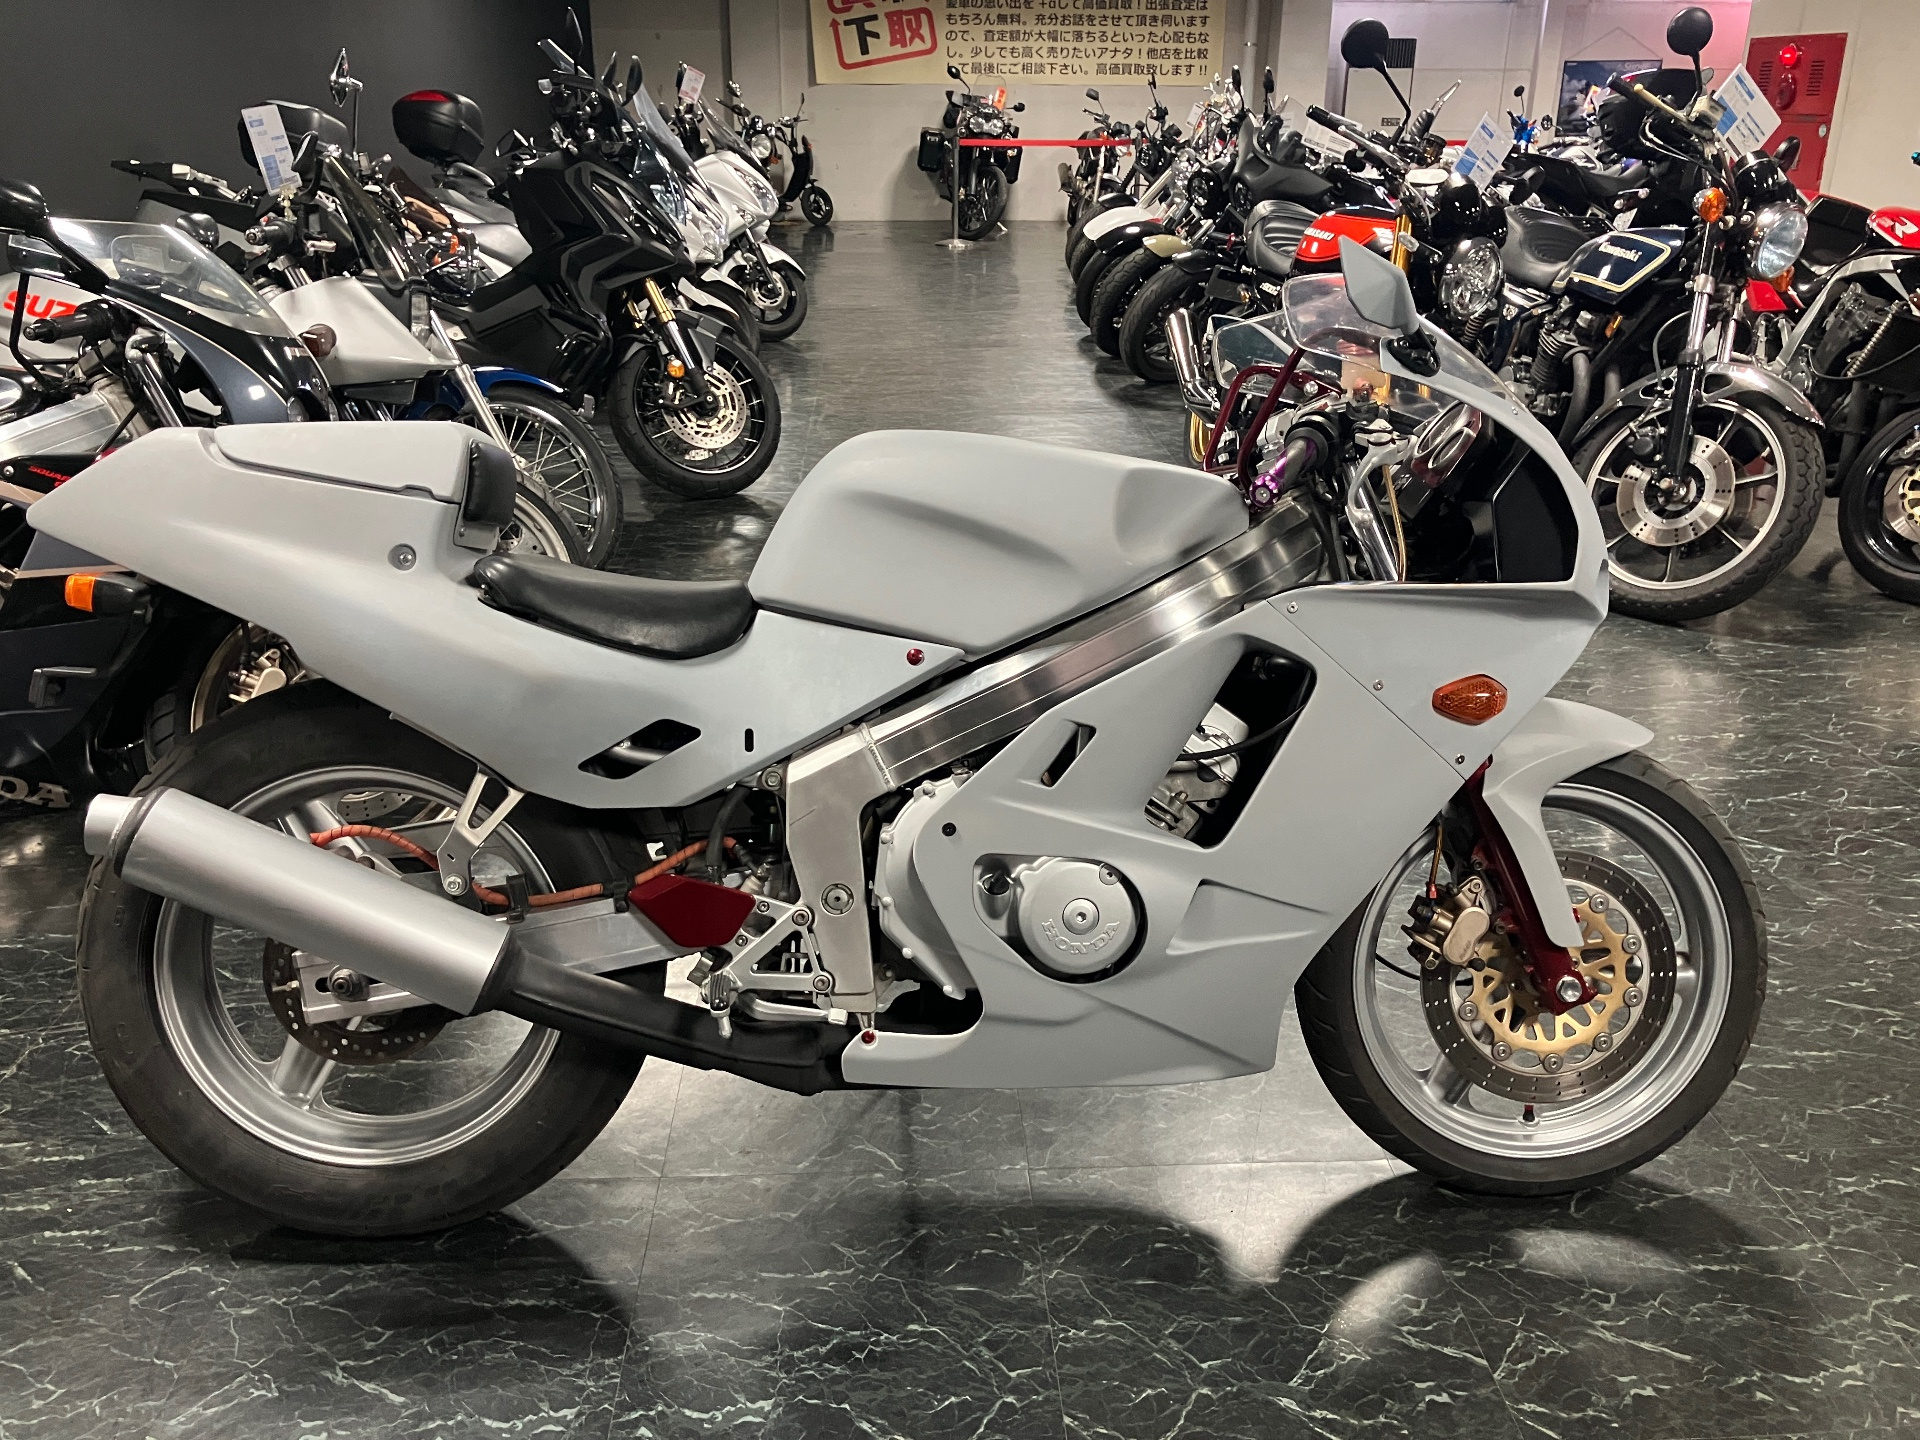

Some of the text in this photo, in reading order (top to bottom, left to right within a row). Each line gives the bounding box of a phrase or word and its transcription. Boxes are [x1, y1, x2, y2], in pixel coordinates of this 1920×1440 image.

[945, 13, 1210, 27] もちろん無料。充分お話をさせて頂き伺います
[843, 10, 926, 55] 下取
[945, 29, 1210, 43] ので、査定額が大幅に落ちるといった心配もな
[1598, 241, 1642, 262] Kawasaki
[1041, 918, 1121, 955] HONDA
